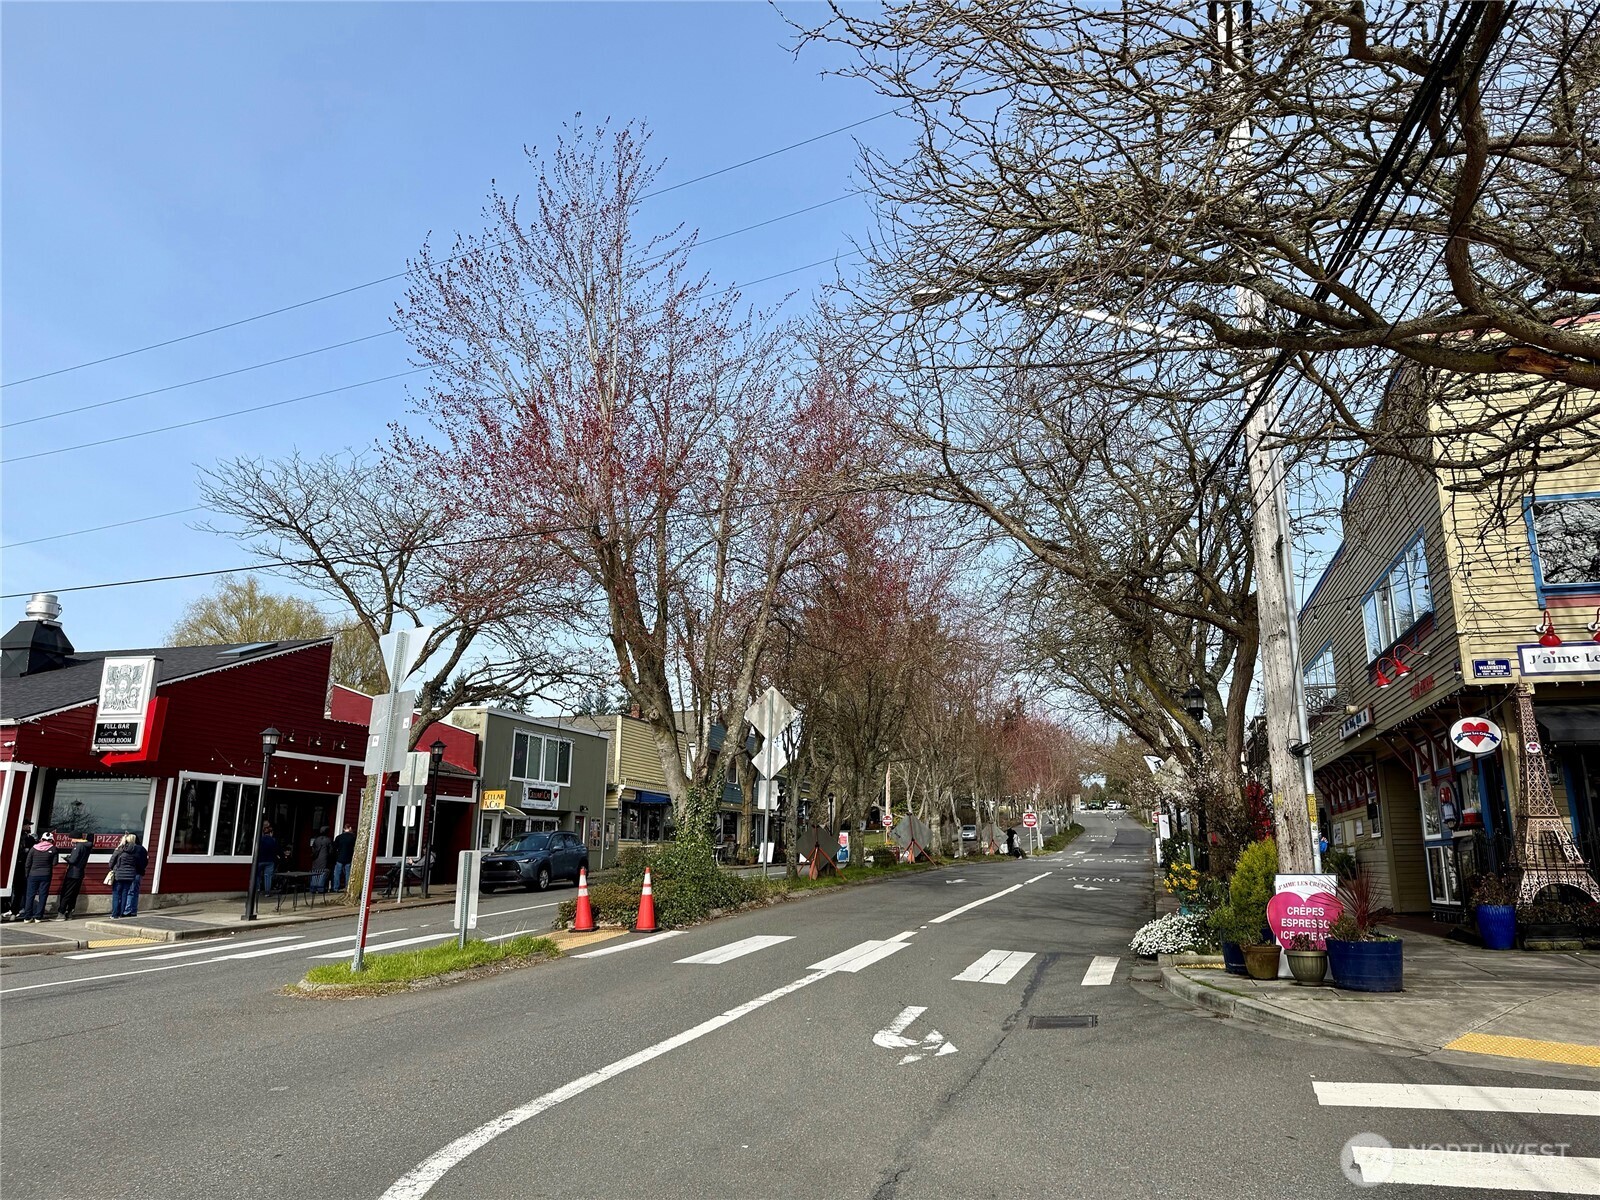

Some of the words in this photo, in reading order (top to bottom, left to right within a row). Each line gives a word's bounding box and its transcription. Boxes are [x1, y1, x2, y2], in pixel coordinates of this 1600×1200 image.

[1529, 654, 1580, 665] J'aime
[482, 791, 504, 801] CELLAR
[96, 835, 121, 843] PIZZ
[1277, 881, 1296, 891] J'AIME
[1287, 904, 1325, 916] CRÊPES
